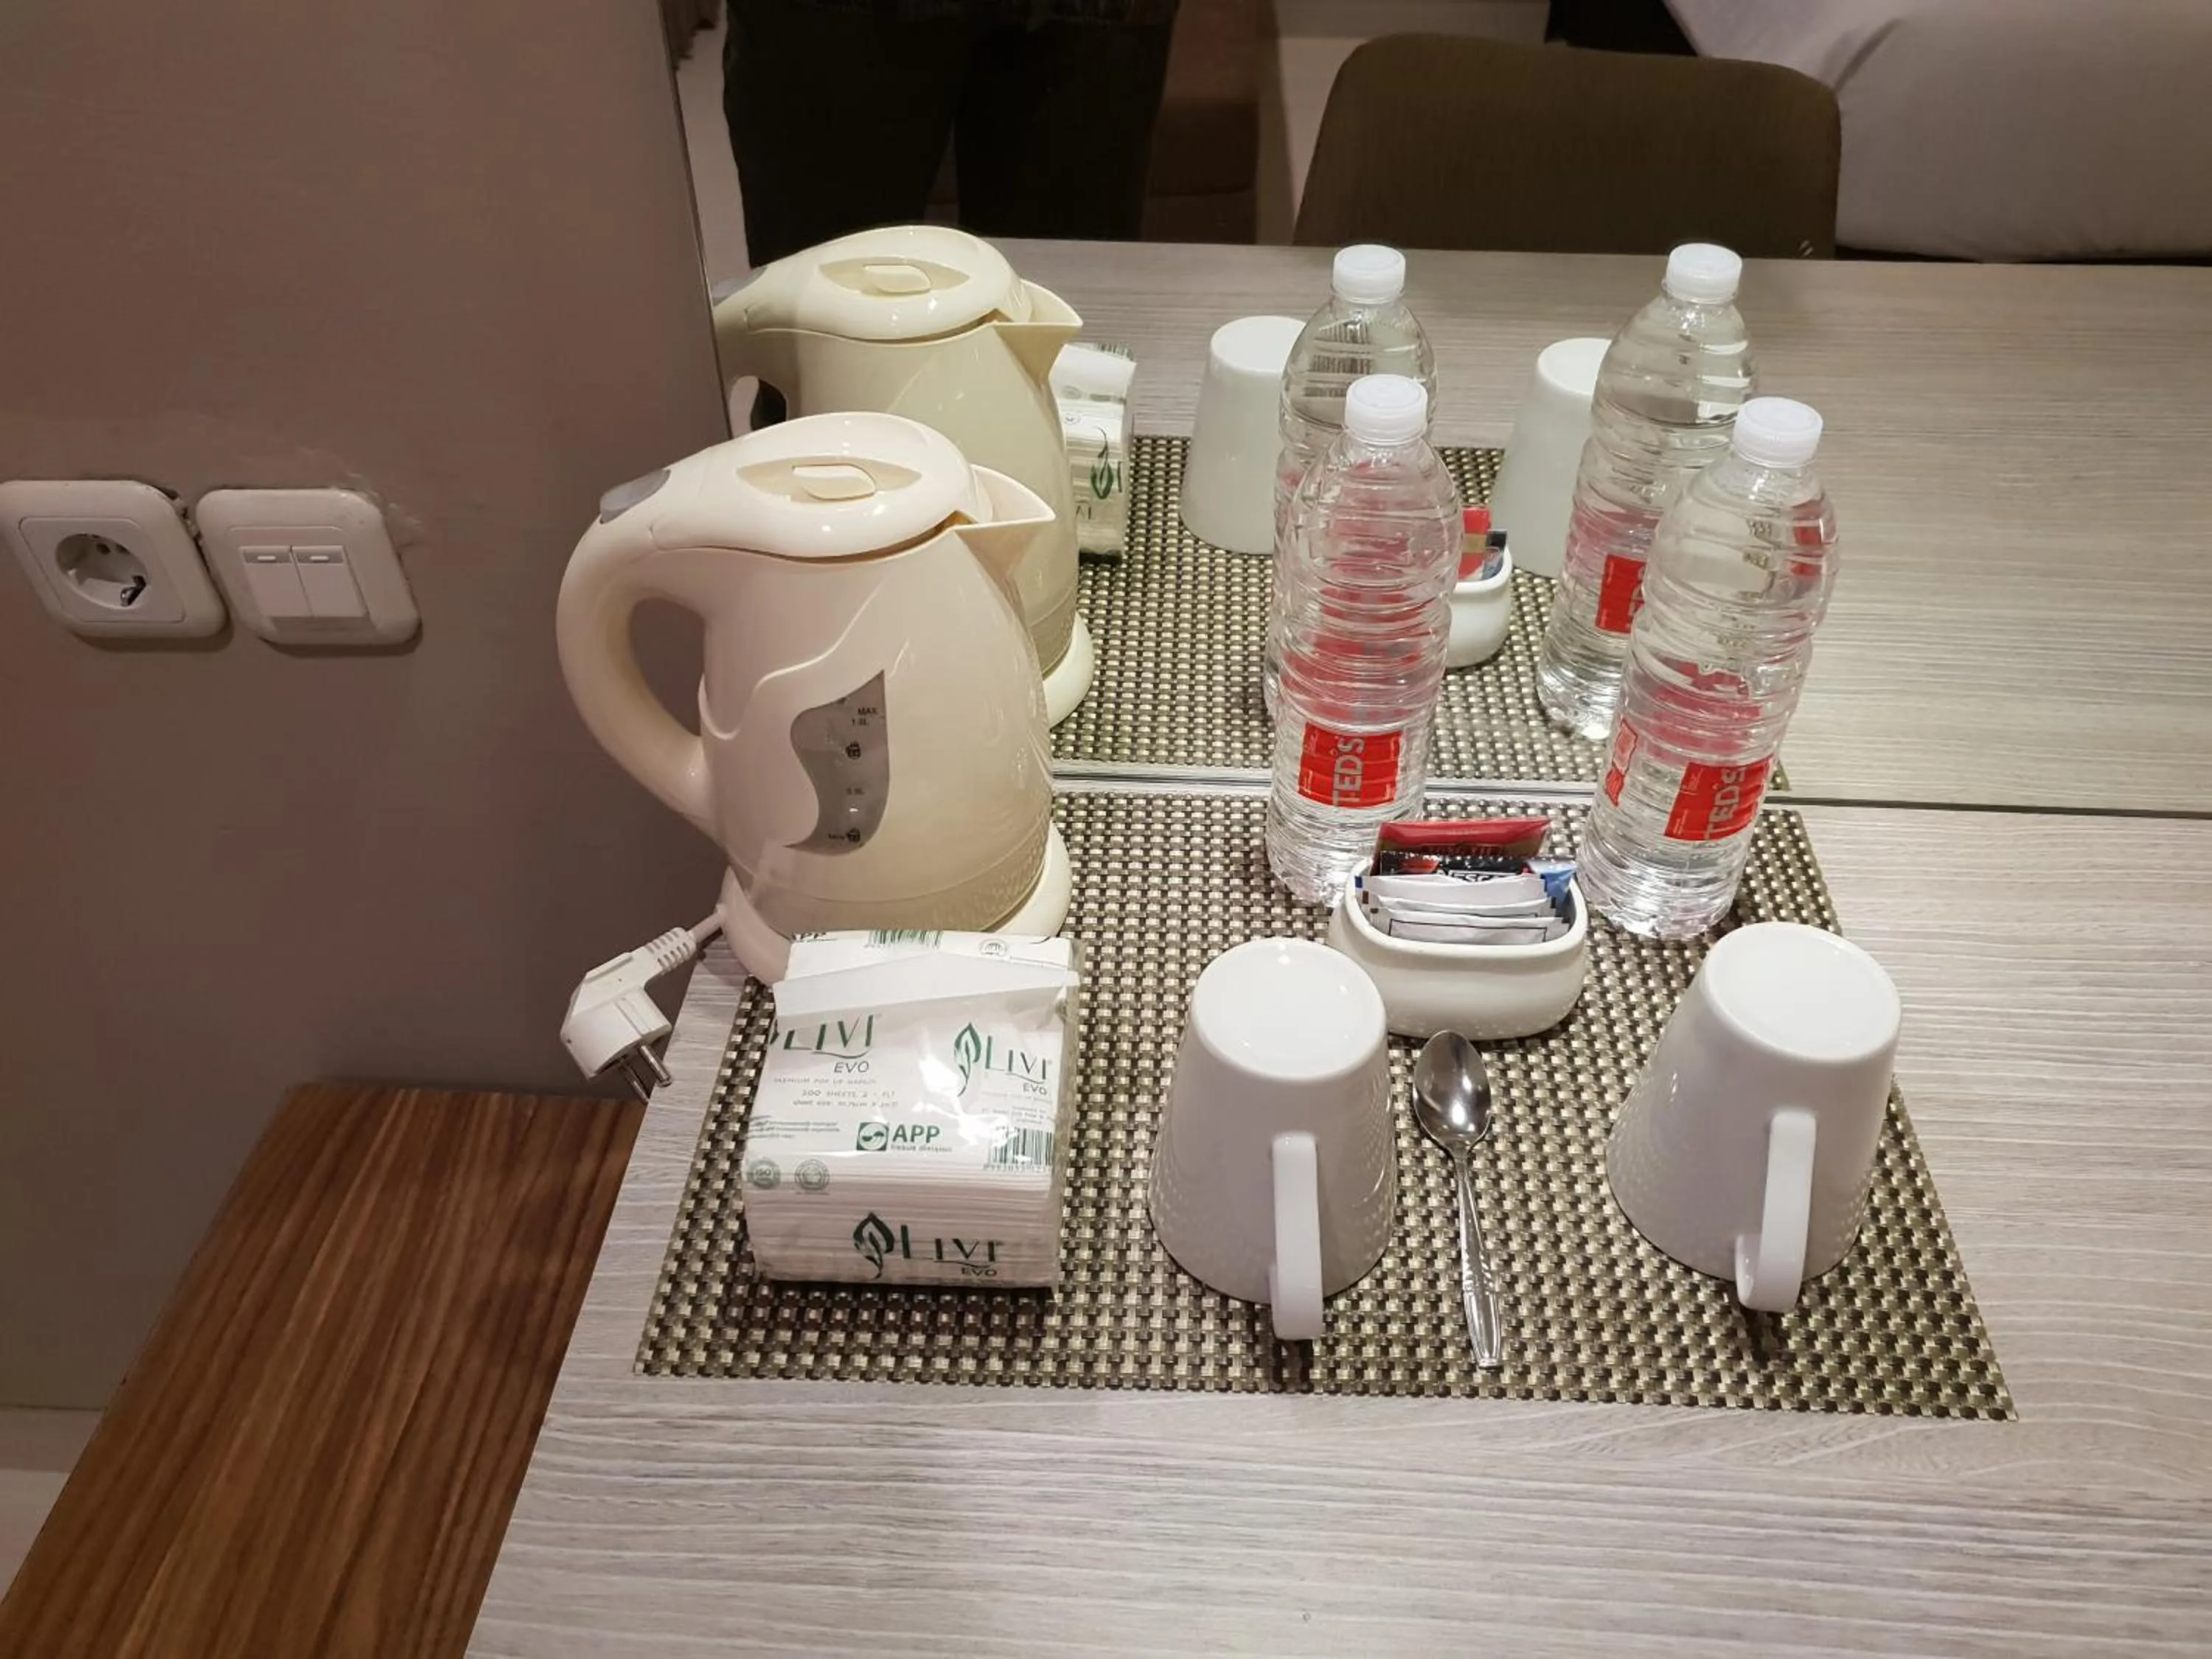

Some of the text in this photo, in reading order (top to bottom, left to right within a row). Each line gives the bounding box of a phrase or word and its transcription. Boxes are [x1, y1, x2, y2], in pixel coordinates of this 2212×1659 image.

[985, 1034, 1046, 1080] LIVI
[834, 1060, 869, 1074] EVO
[1023, 1082, 1047, 1095] EVO
[891, 1124, 940, 1143] APP
[961, 1267, 997, 1276] EVO
